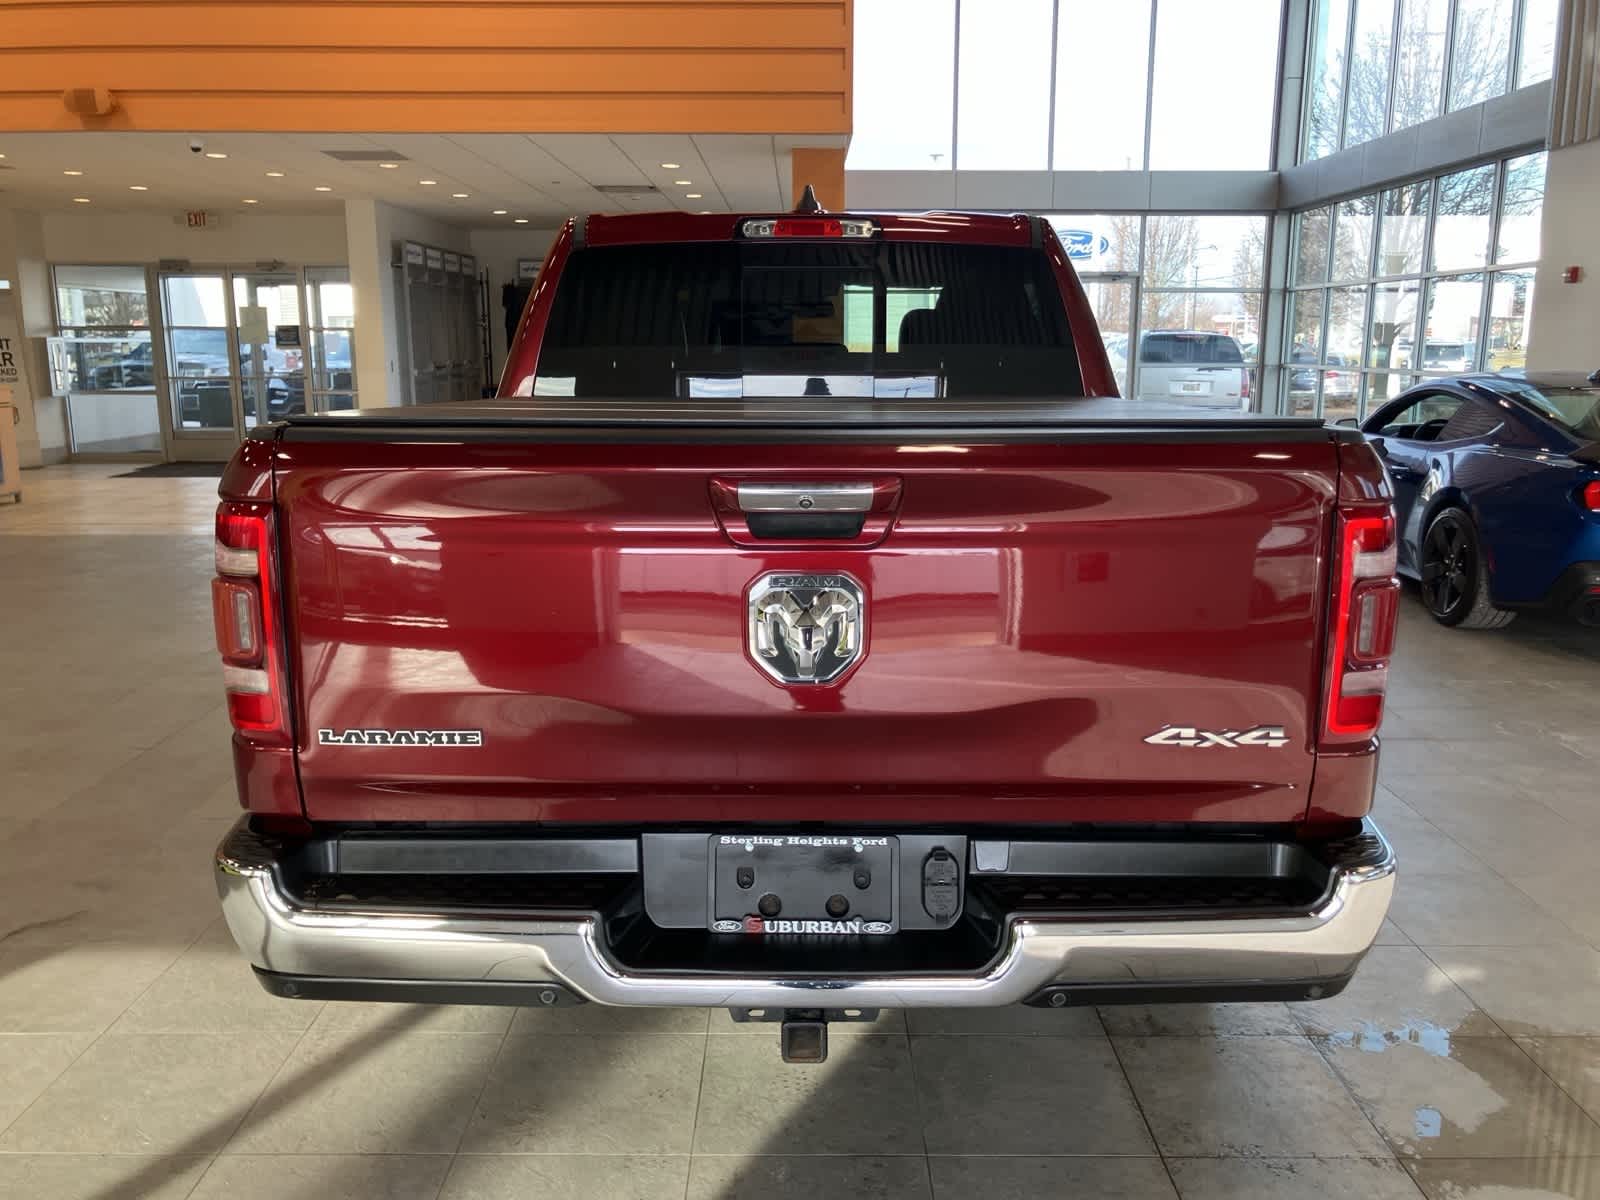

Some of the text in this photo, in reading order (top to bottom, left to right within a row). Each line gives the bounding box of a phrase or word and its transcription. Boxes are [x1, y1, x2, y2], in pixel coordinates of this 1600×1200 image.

[187, 211, 206, 227] EXIT
[771, 576, 841, 588] RAM
[318, 729, 482, 747] LARAMIE
[720, 836, 888, 847] Sterling Heights Ford
[744, 916, 860, 934] SUBURBAN
